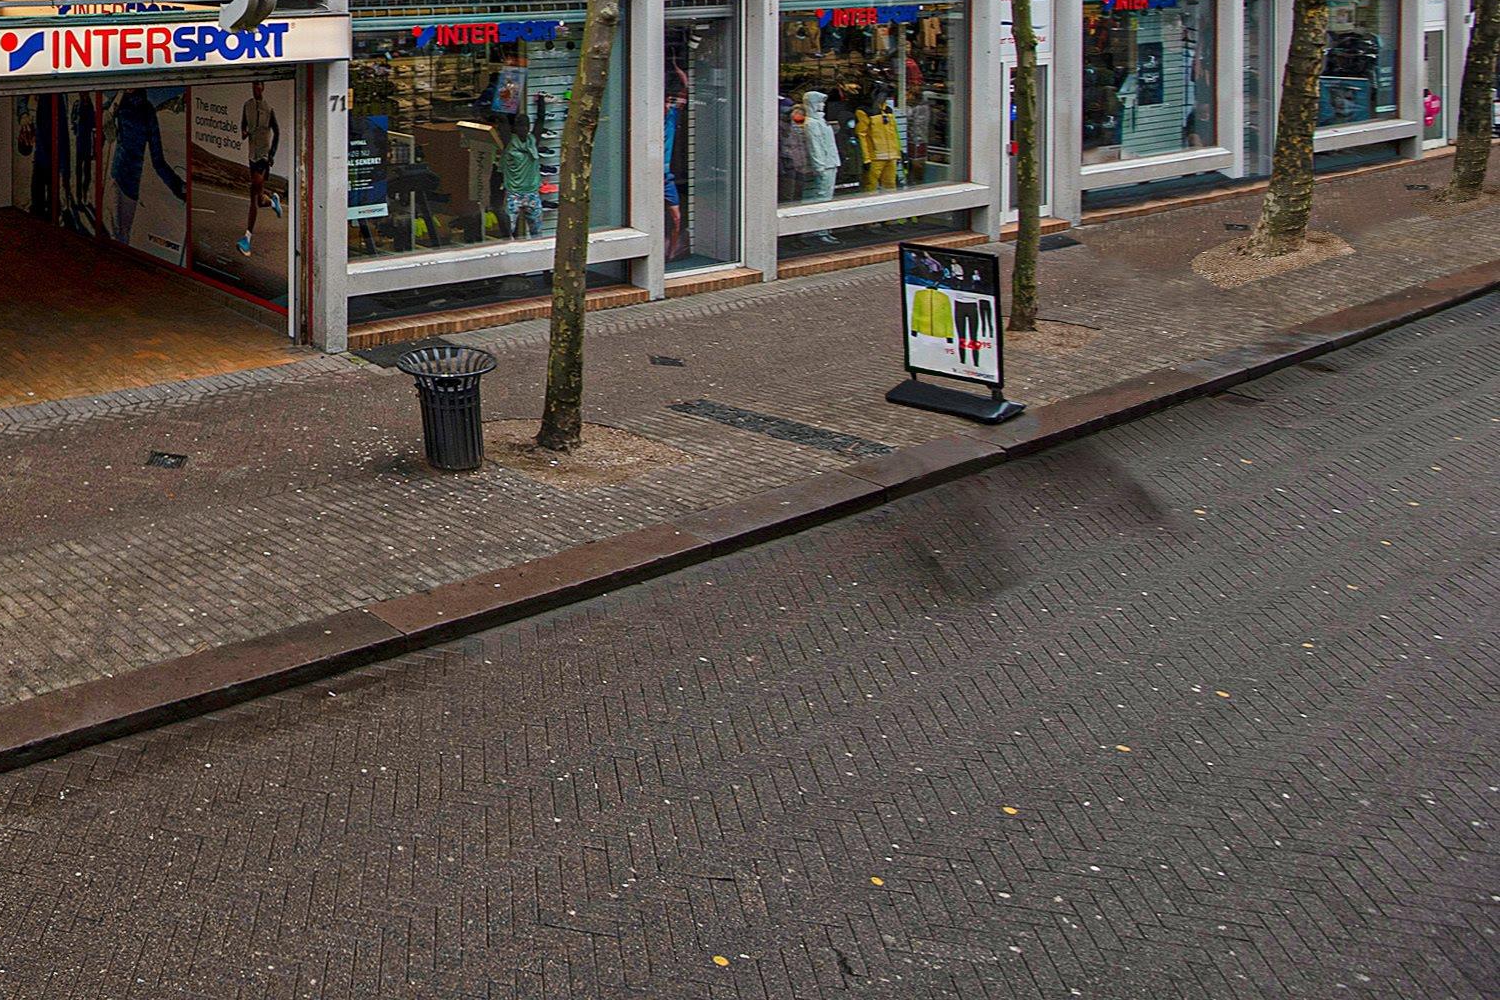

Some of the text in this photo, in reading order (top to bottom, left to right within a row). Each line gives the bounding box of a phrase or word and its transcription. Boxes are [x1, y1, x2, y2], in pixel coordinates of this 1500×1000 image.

[52, 22, 290, 70] INTERSPORT
[196, 98, 228, 115] The most
[330, 94, 346, 112] 71
[195, 115, 238, 134] comfortable
[195, 131, 222, 148] running
